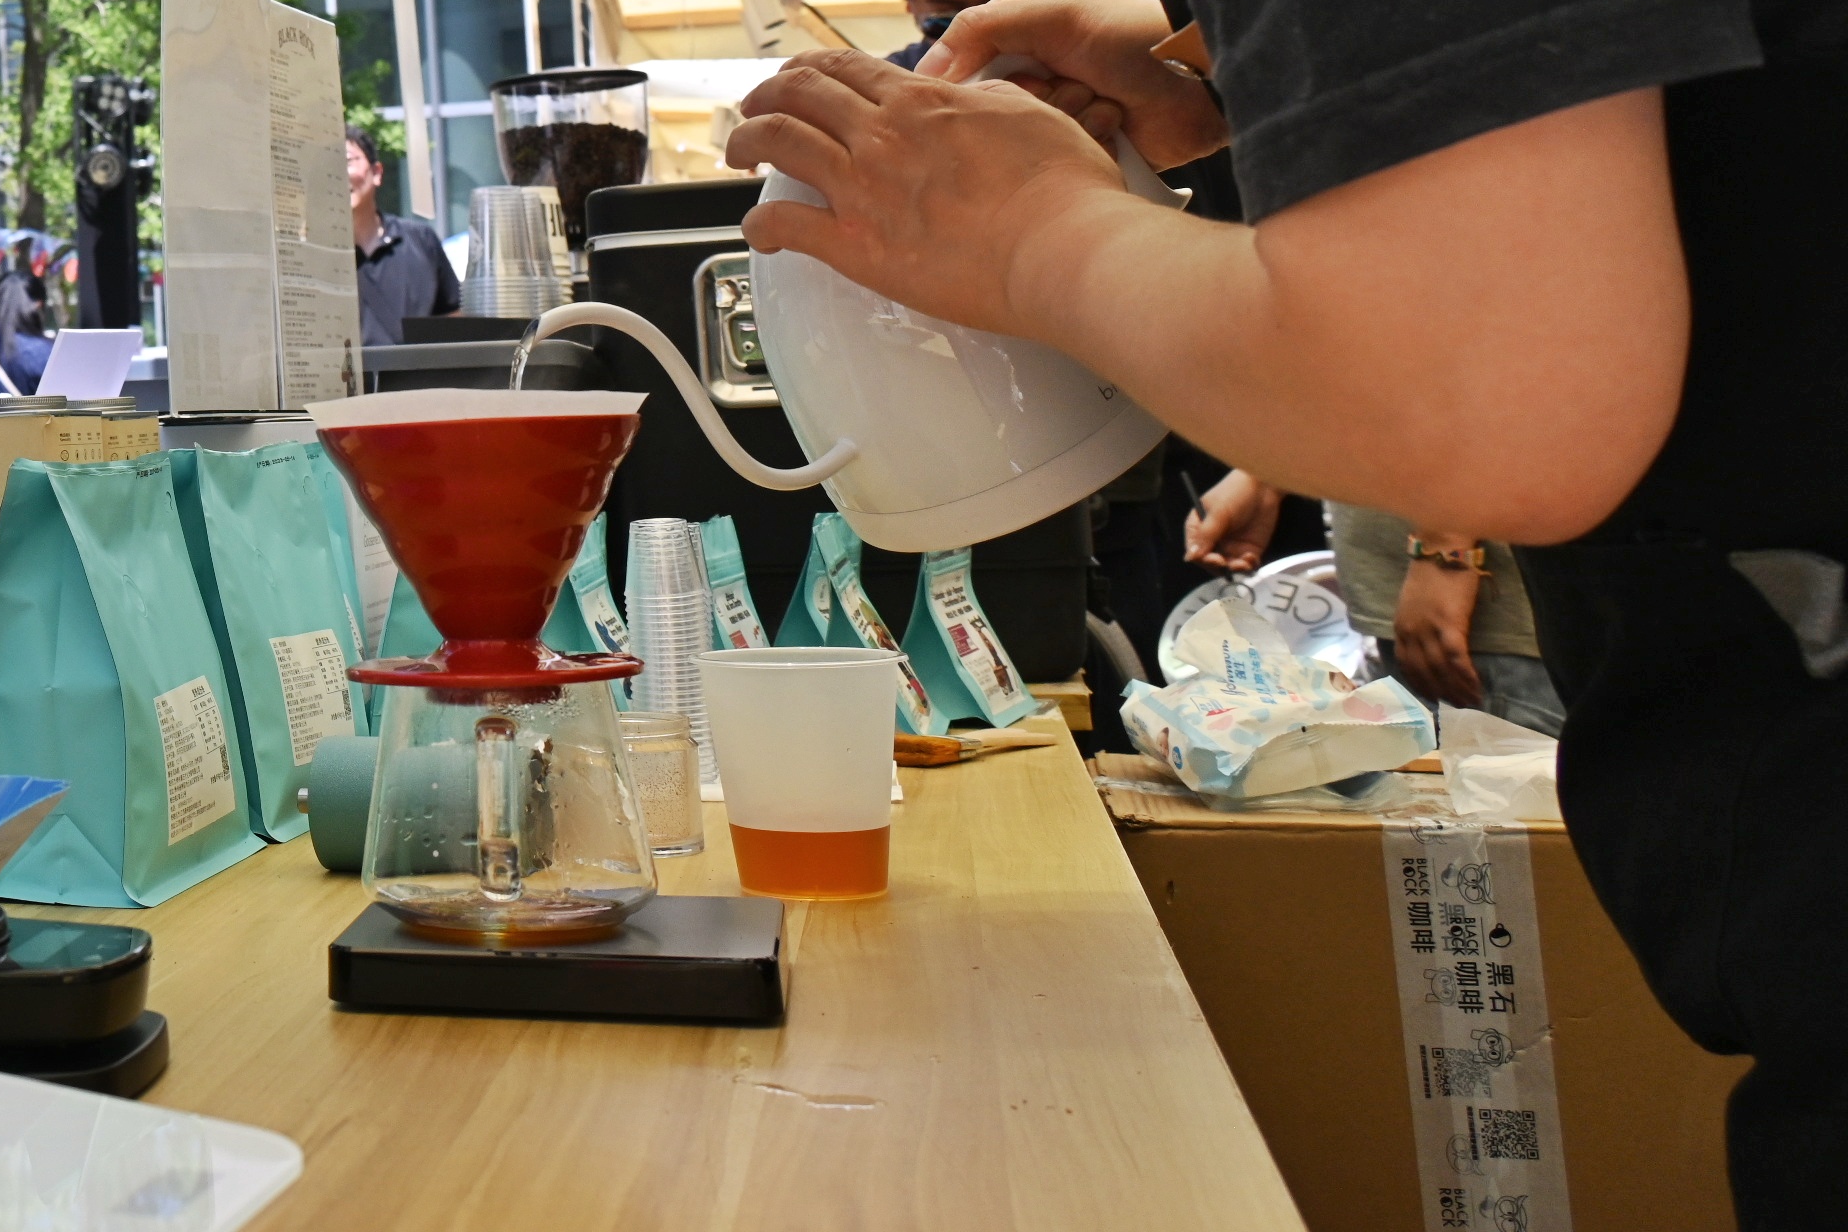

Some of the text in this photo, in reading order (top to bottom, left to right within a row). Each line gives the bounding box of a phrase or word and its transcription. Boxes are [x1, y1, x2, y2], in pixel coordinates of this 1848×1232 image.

[1402, 857, 1419, 897] ROCK
[1416, 857, 1431, 896] BLACK
[1407, 901, 1436, 955] 咖啡
[1464, 917, 1480, 957] BLACK
[1454, 961, 1484, 1015] 咖啡
[1485, 961, 1516, 1015] 黑石
[1439, 1187, 1456, 1228] ROCK
[1454, 1187, 1470, 1229] BLACK
